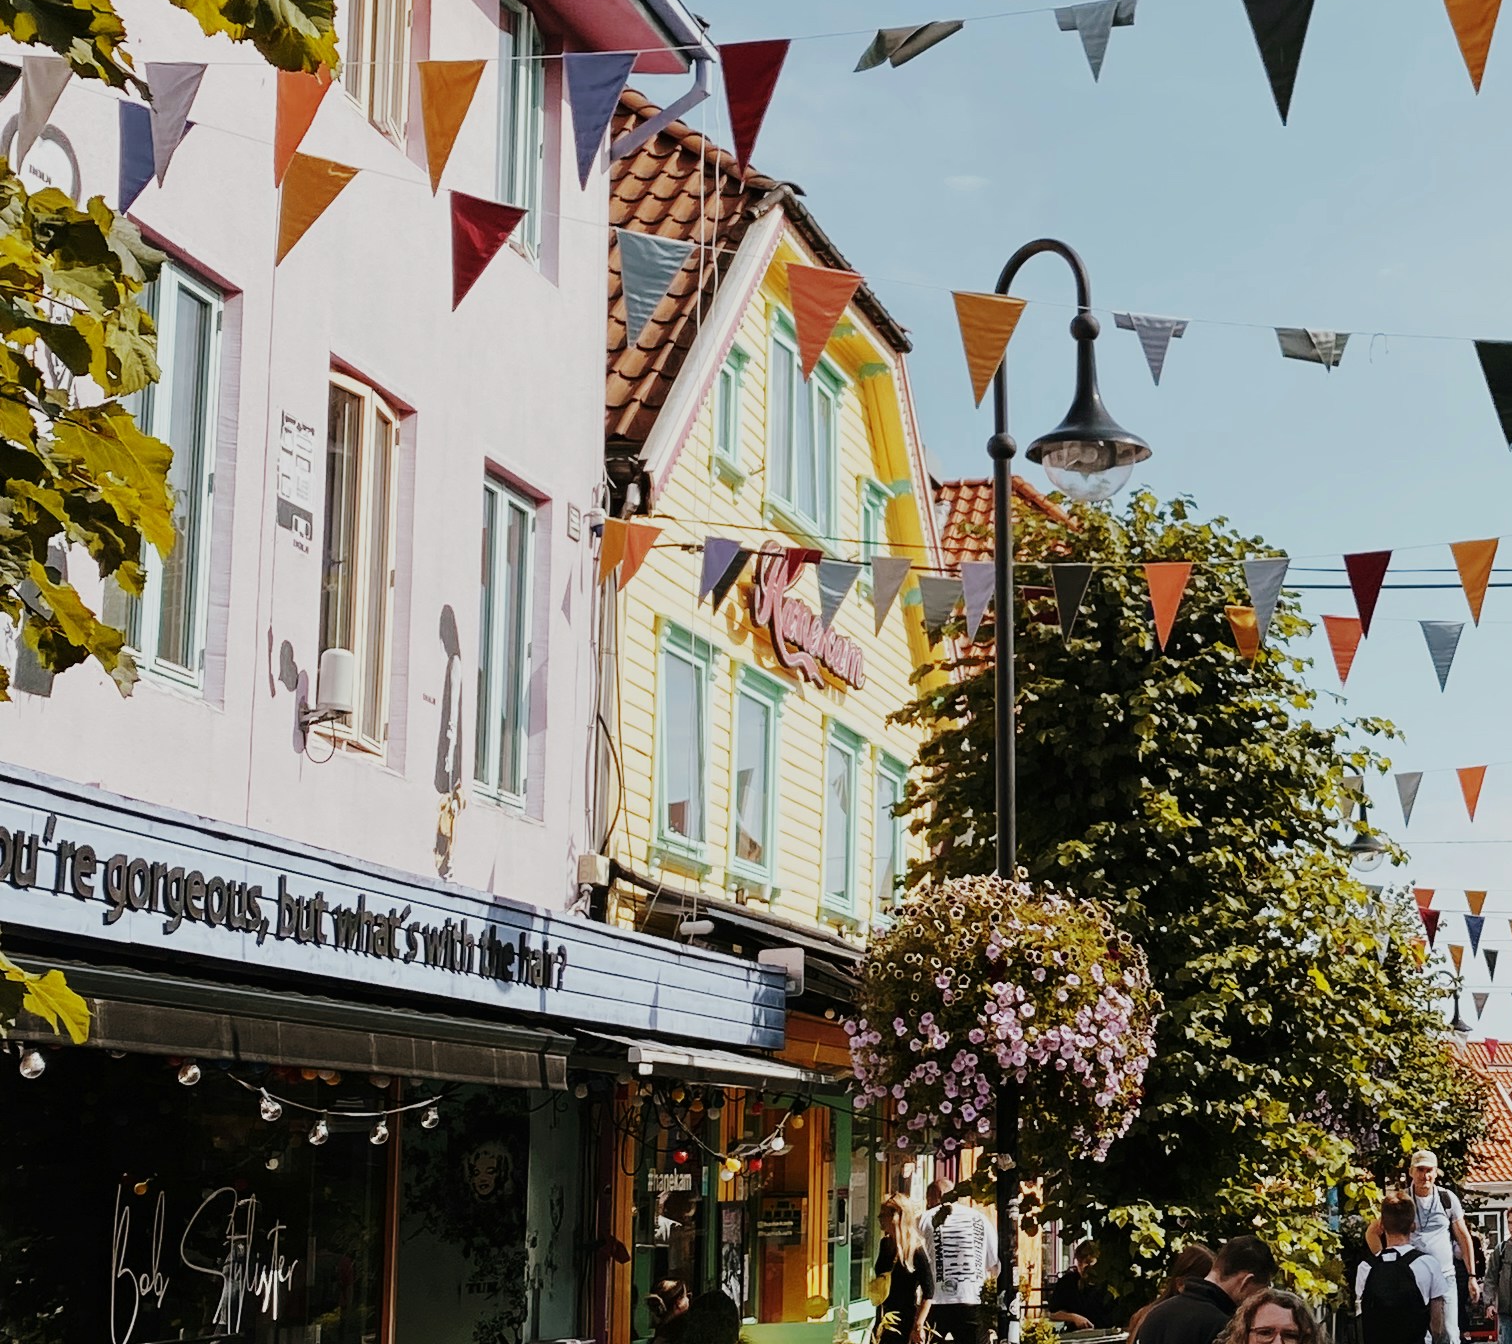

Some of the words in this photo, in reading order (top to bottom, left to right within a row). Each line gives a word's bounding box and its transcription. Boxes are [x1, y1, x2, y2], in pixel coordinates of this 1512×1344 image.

[0, 812, 97, 902] ou're
[103, 853, 269, 947] gorgeous,
[277, 874, 328, 945] but
[330, 893, 420, 963] what's
[421, 916, 475, 975] with
[478, 924, 515, 982] the
[518, 931, 568, 989] hair?
